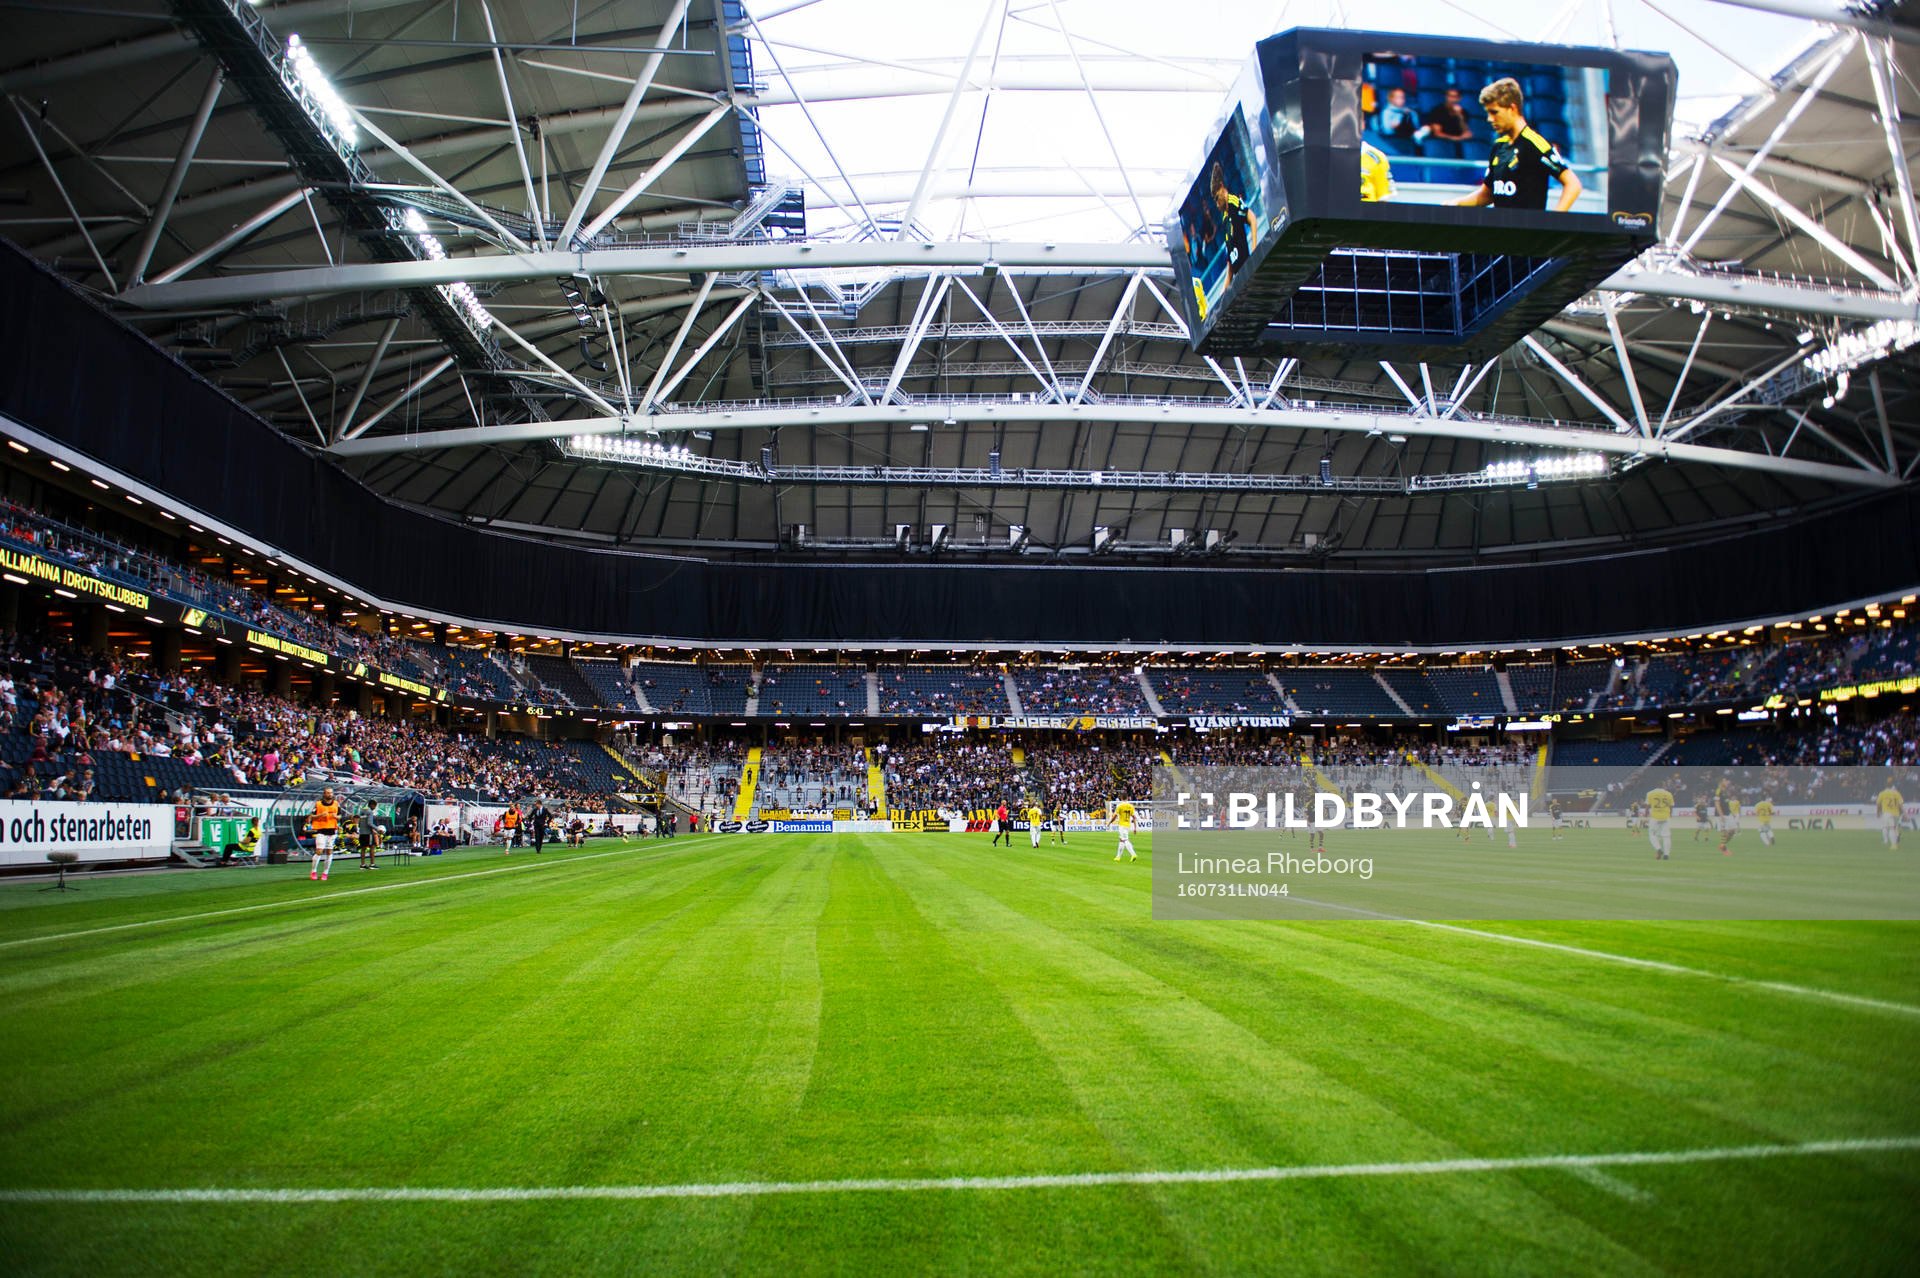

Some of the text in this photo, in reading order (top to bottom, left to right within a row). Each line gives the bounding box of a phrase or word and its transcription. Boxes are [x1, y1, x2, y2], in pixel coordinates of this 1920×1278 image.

[0, 548, 149, 610] ALLMÄNNA IDROTTSKLUBBEN
[1188, 717, 1290, 728] IVAN TURIN
[791, 809, 833, 819] ATTACK
[890, 809, 937, 821] BLACK
[11, 809, 45, 843] och
[50, 810, 151, 842] stenarbeten
[775, 821, 832, 832] Bemannia
